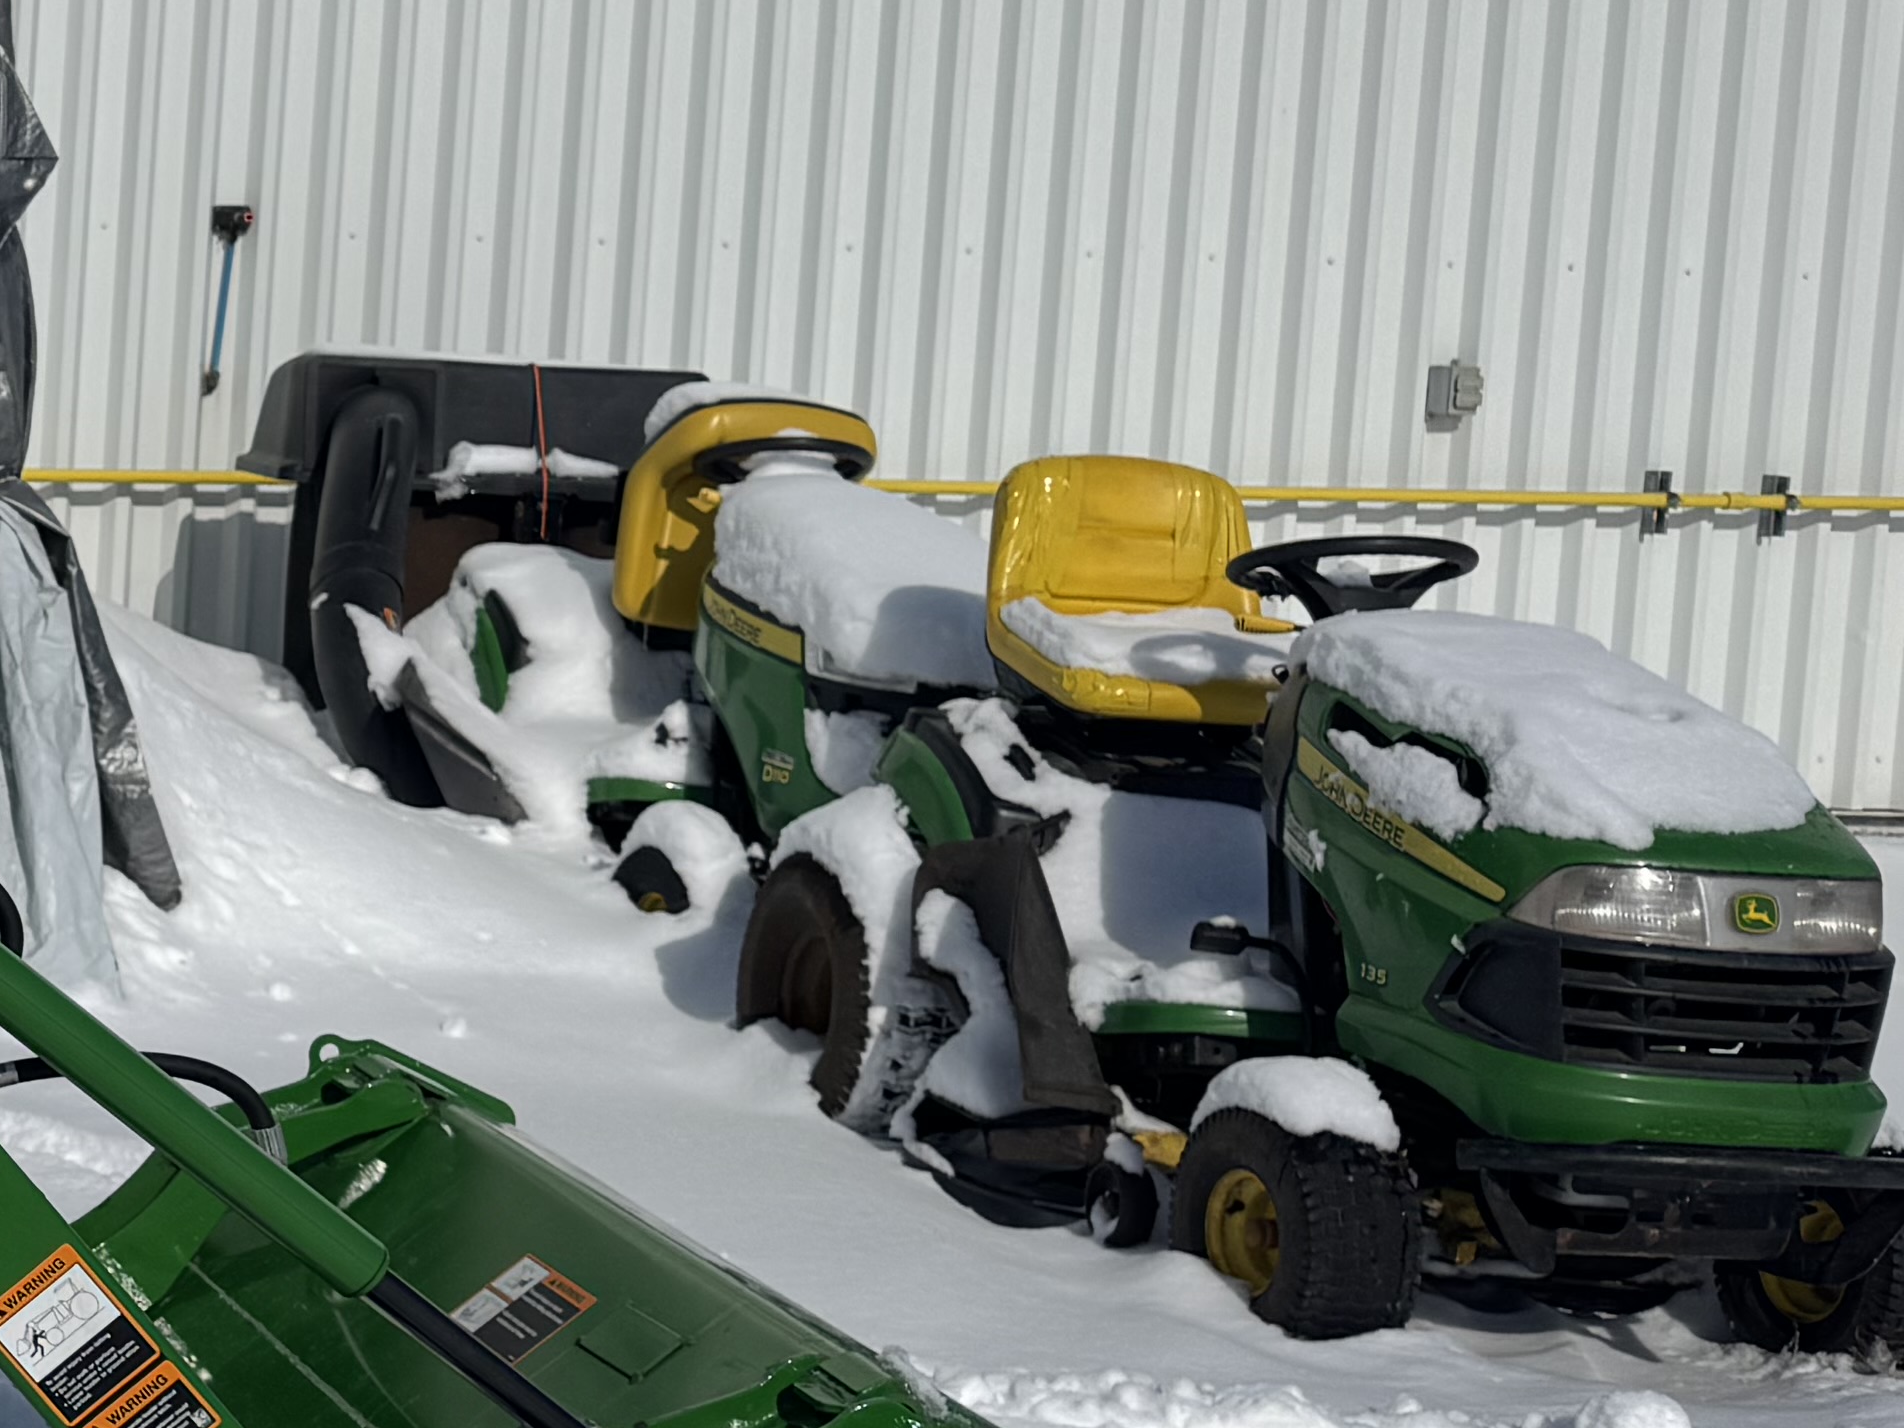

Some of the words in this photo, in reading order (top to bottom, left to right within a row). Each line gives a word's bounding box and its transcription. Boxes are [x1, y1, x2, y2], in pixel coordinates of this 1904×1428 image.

[1349, 791, 1406, 848] DEERE
[1361, 963, 1386, 985] 135
[3, 1257, 66, 1310] WARNING
[105, 1373, 169, 1426] WARNING
